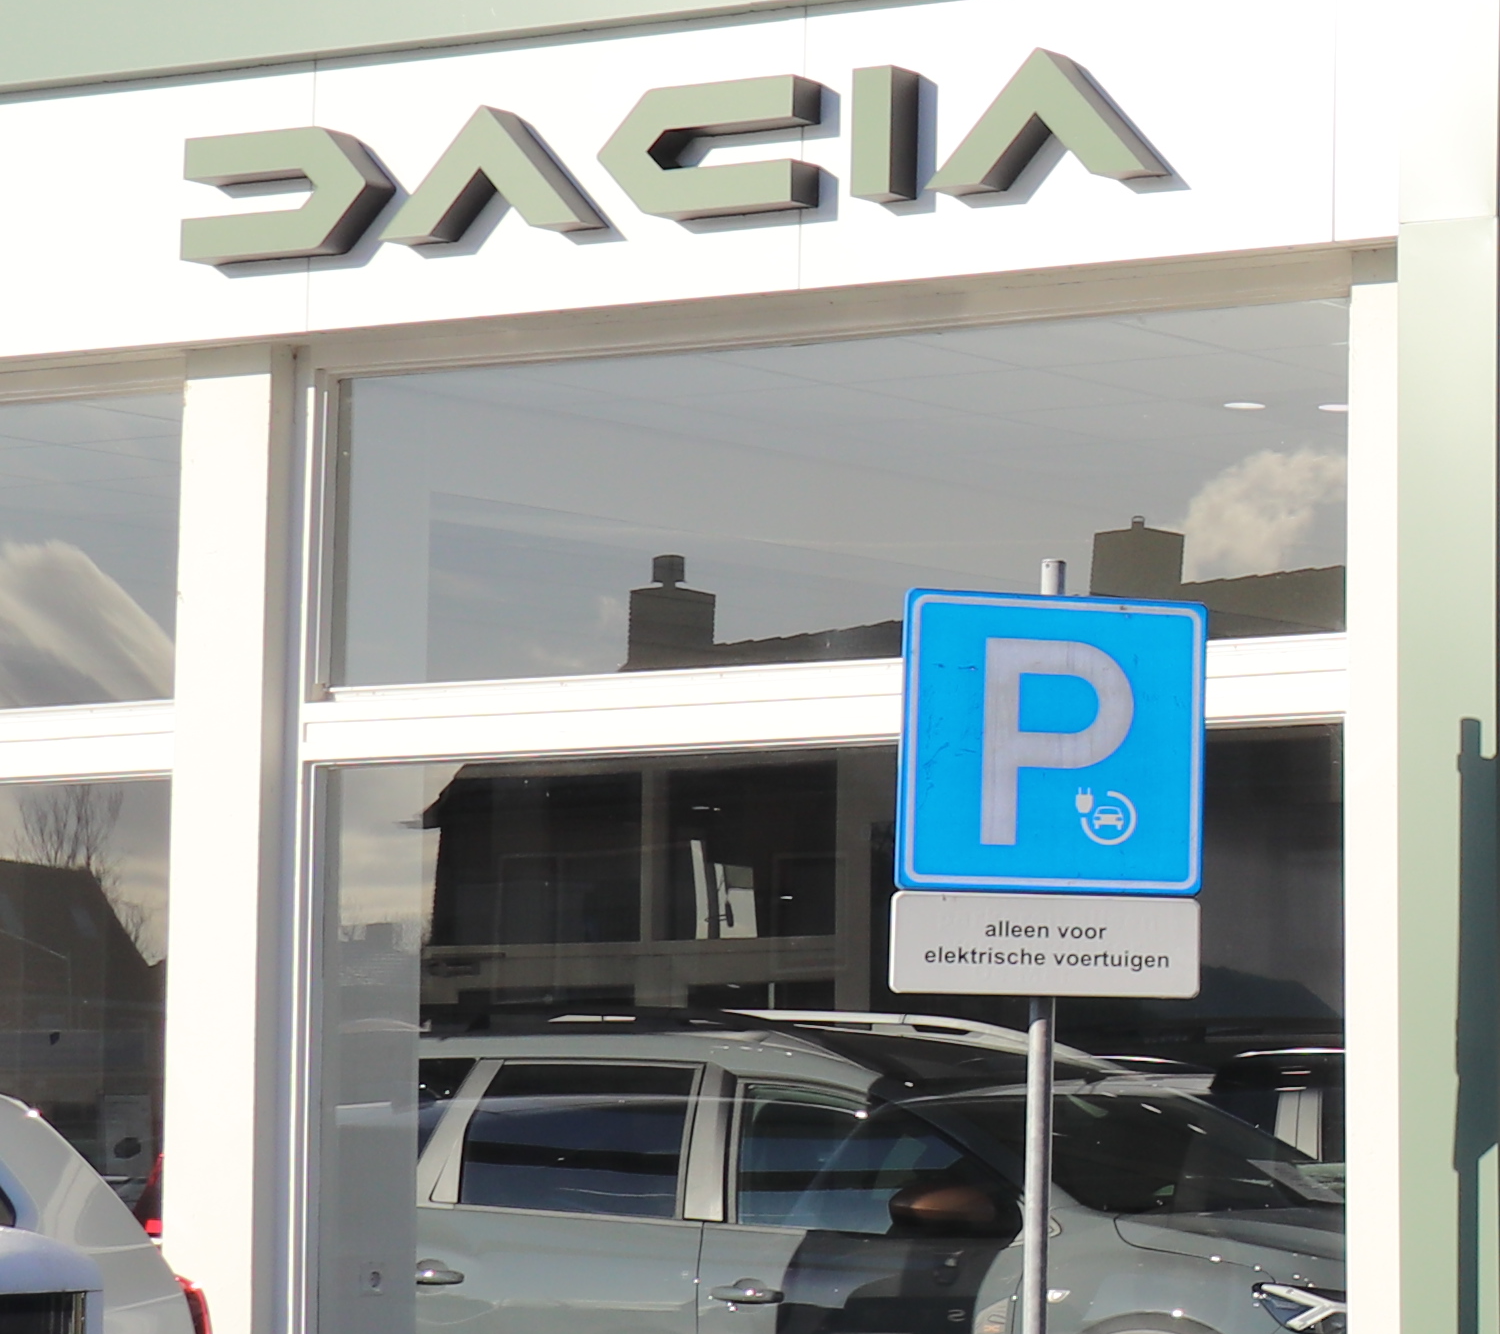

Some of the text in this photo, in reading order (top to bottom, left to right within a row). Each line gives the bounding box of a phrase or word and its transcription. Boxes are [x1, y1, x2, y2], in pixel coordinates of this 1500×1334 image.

[181, 47, 1173, 266] DACIA
[980, 637, 1135, 846] P
[924, 946, 1170, 972] elektrische voertuigen
[985, 921, 1108, 940] alleen voor
